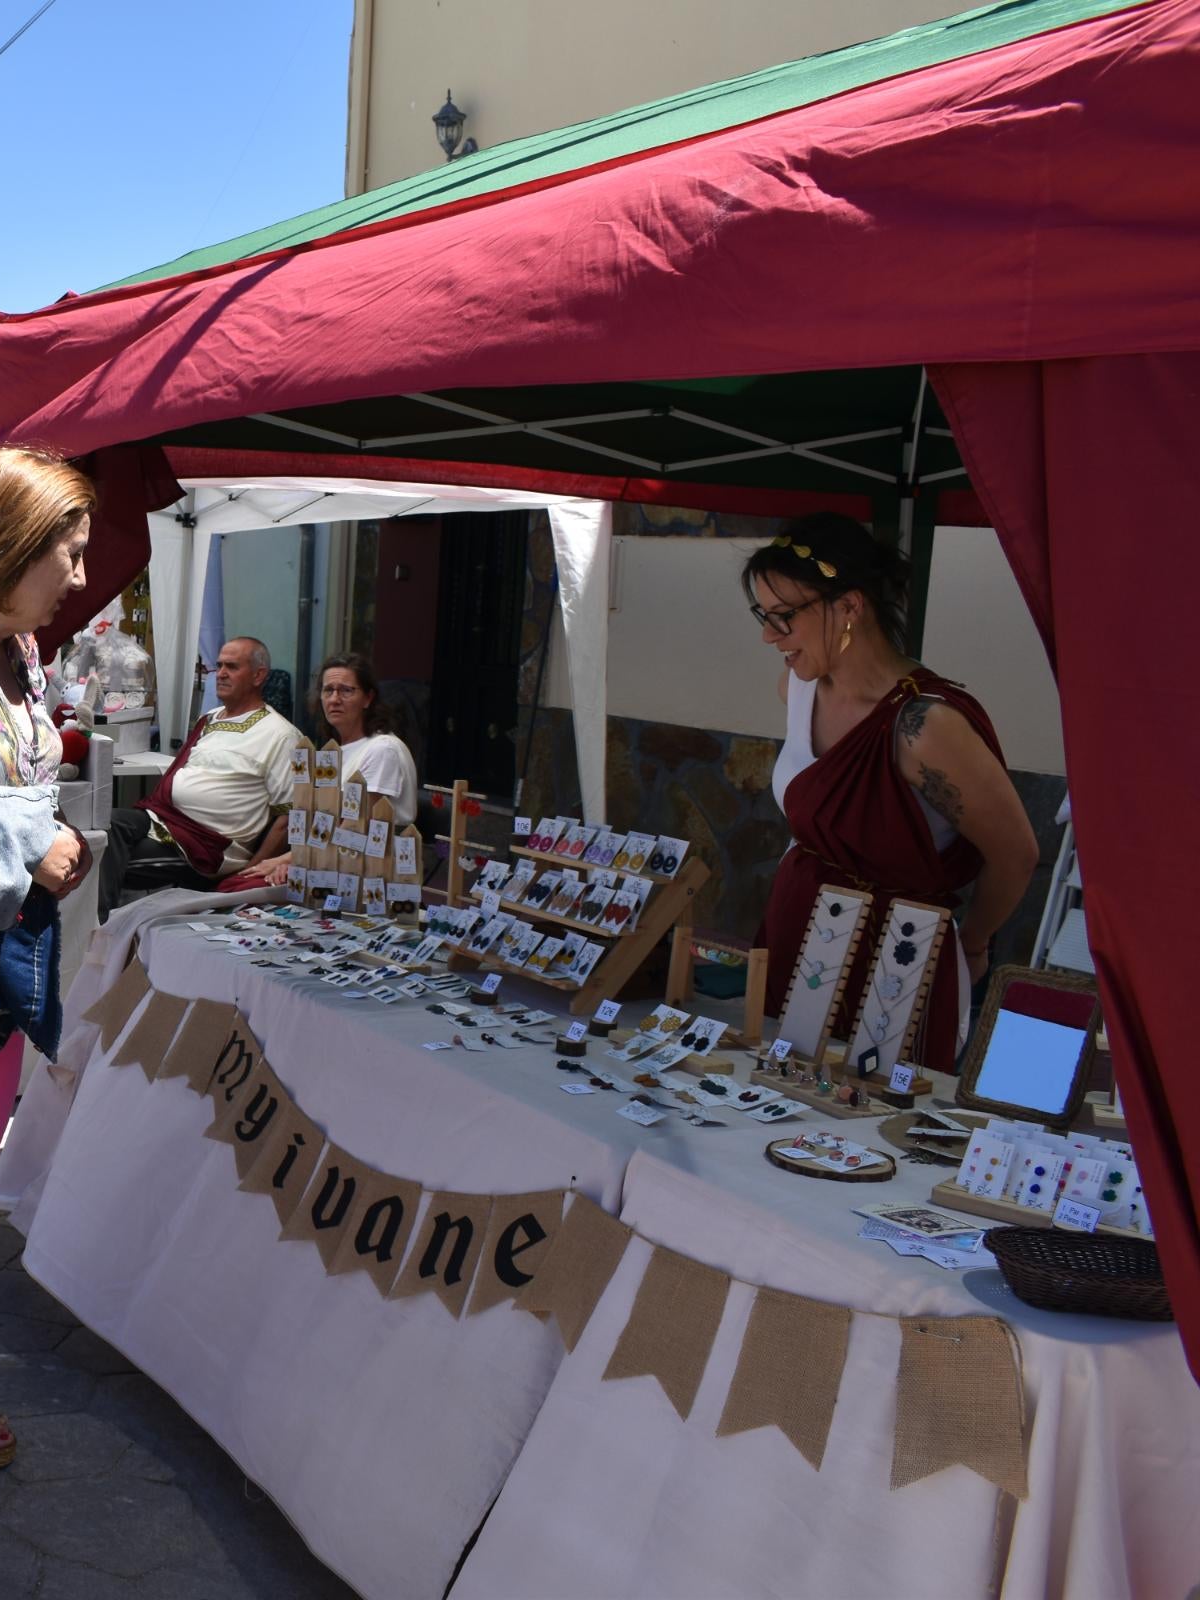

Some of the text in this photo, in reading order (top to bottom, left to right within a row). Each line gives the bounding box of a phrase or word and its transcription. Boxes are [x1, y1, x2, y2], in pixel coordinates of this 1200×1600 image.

[516, 822, 530, 832] 10€
[485, 979, 498, 989] 10€
[601, 1005, 616, 1017] 12€
[570, 1026, 584, 1038] 10€
[894, 1072, 910, 1086] 15€
